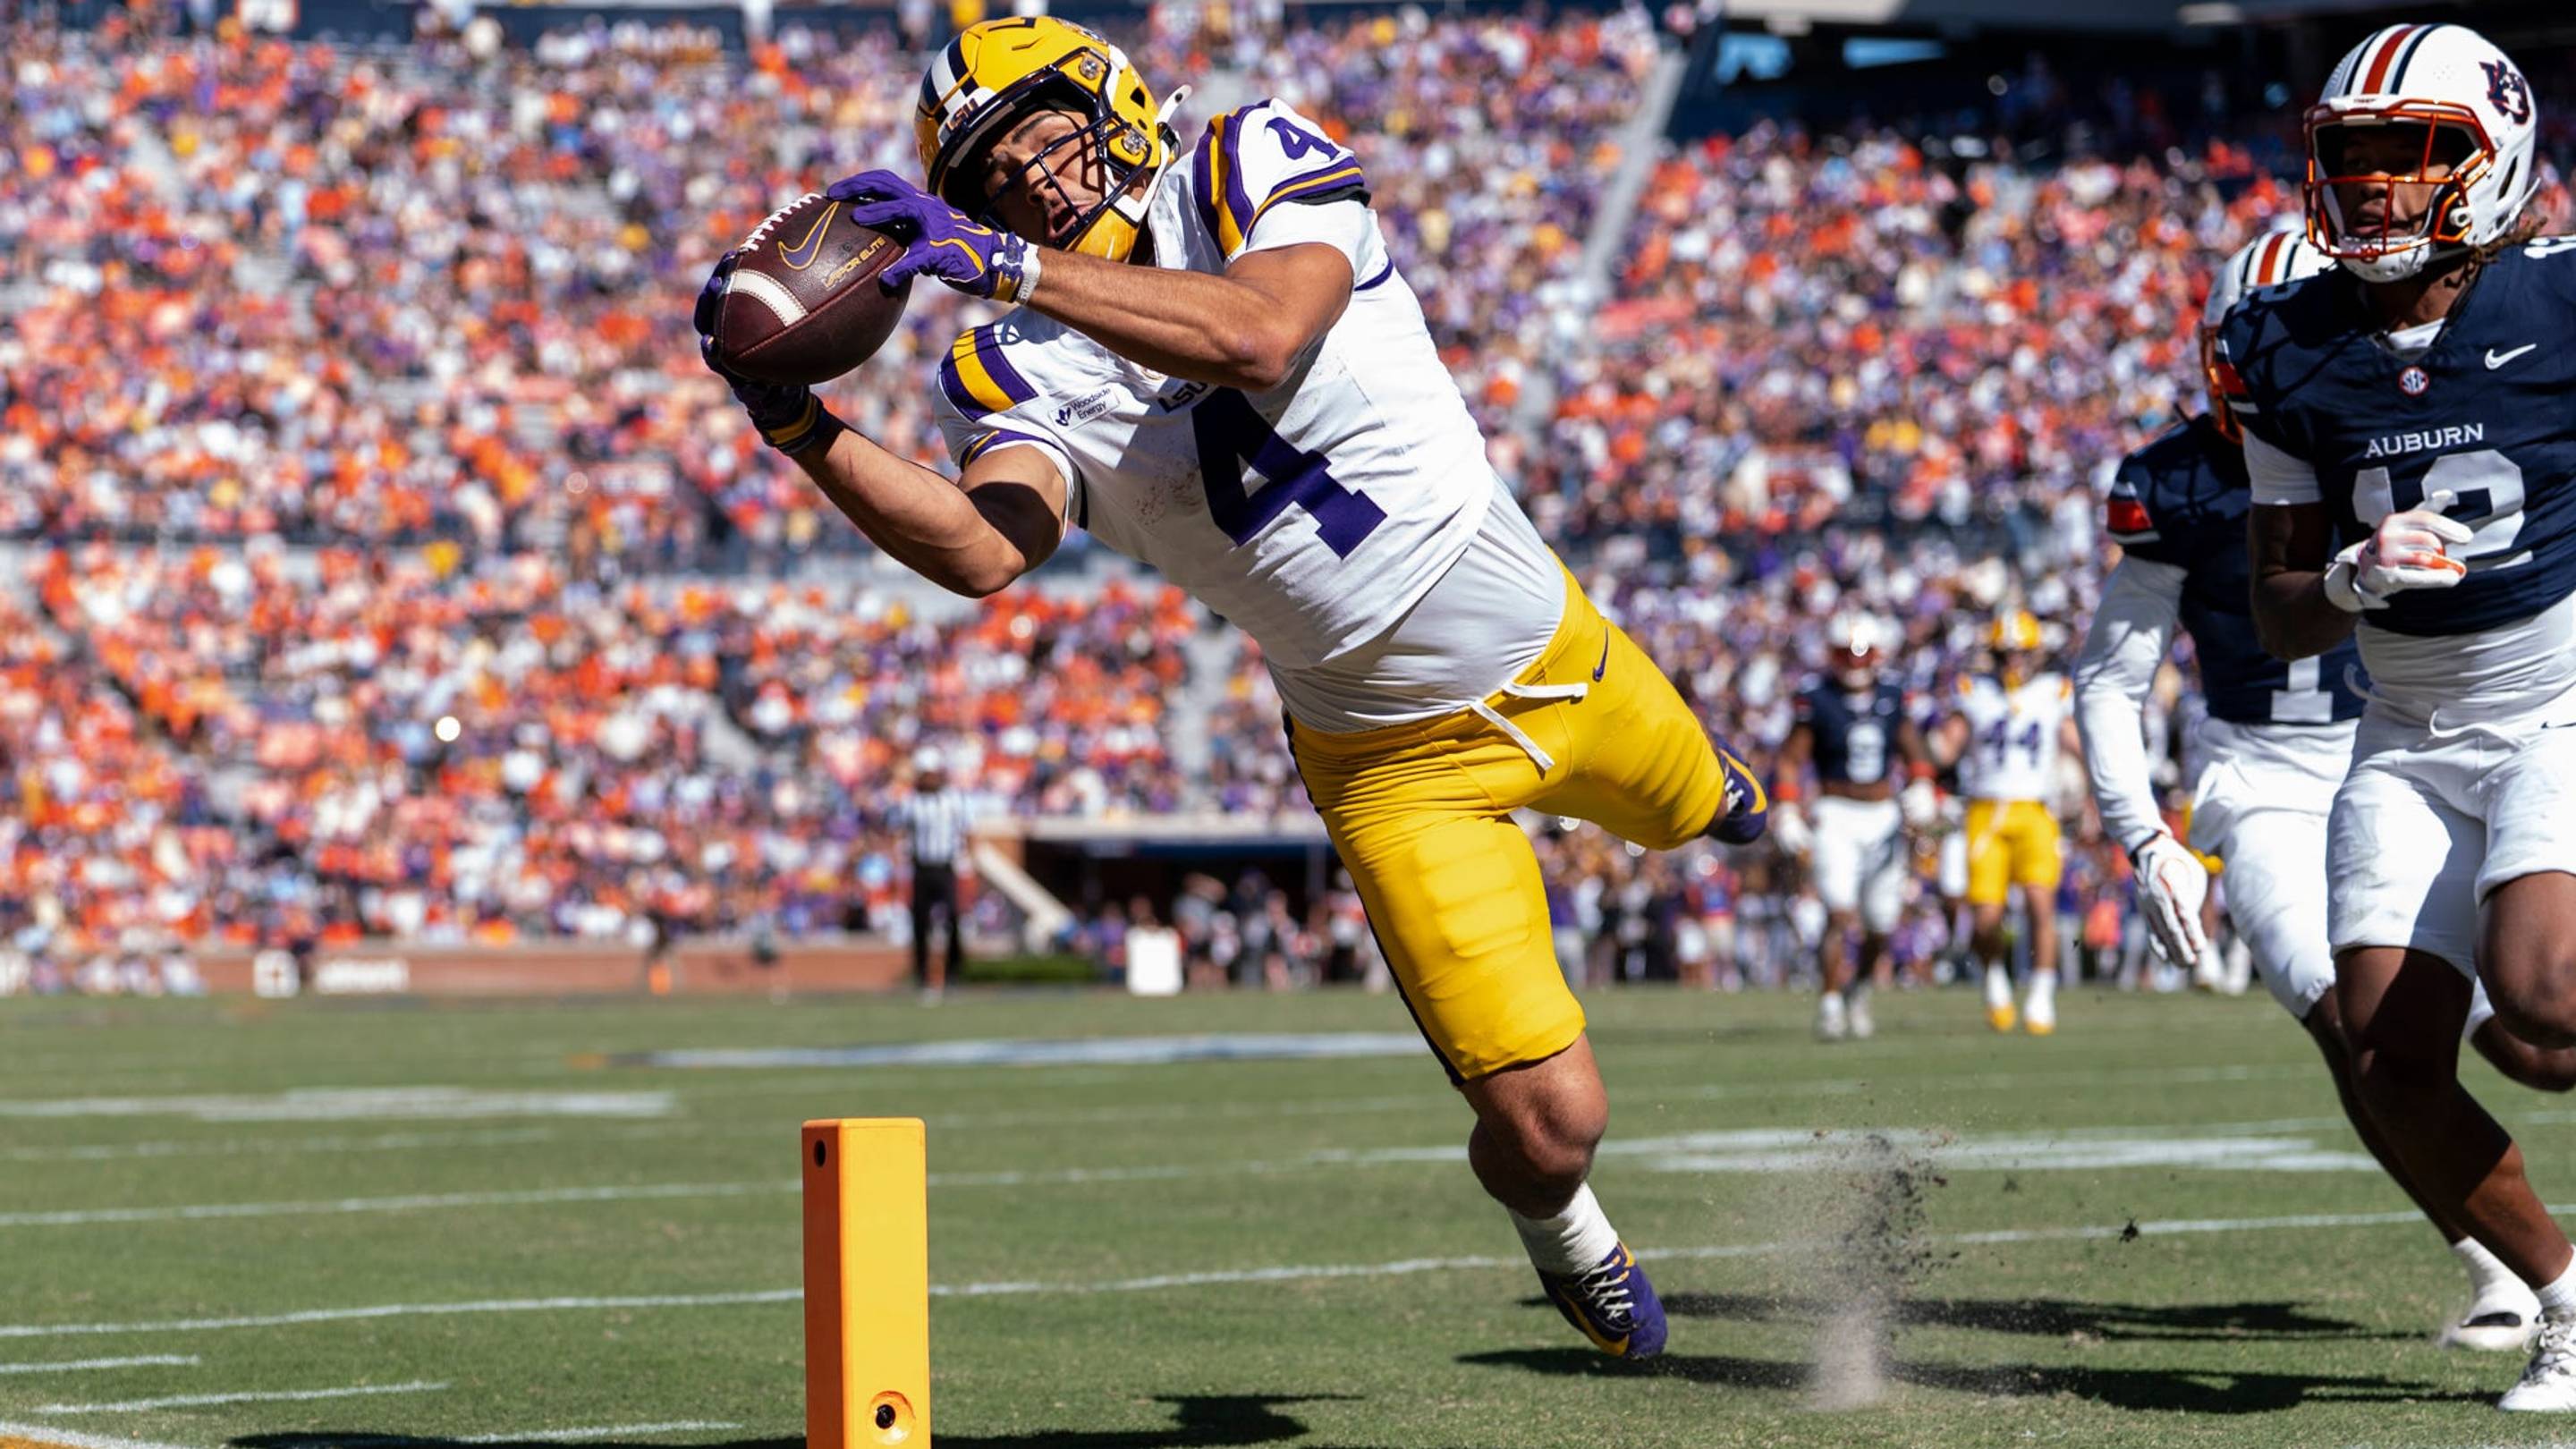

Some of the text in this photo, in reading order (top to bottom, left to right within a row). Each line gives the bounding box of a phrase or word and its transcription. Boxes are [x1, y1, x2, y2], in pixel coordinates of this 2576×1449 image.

[1265, 116, 1341, 162] 4
[1072, 386, 1112, 412] Woodside
[1077, 400, 1107, 419] Energy
[1157, 381, 1208, 413] LSU
[2365, 423, 2484, 458] AUBURN
[1191, 386, 1388, 561] 4
[1981, 718, 2040, 767] 44
